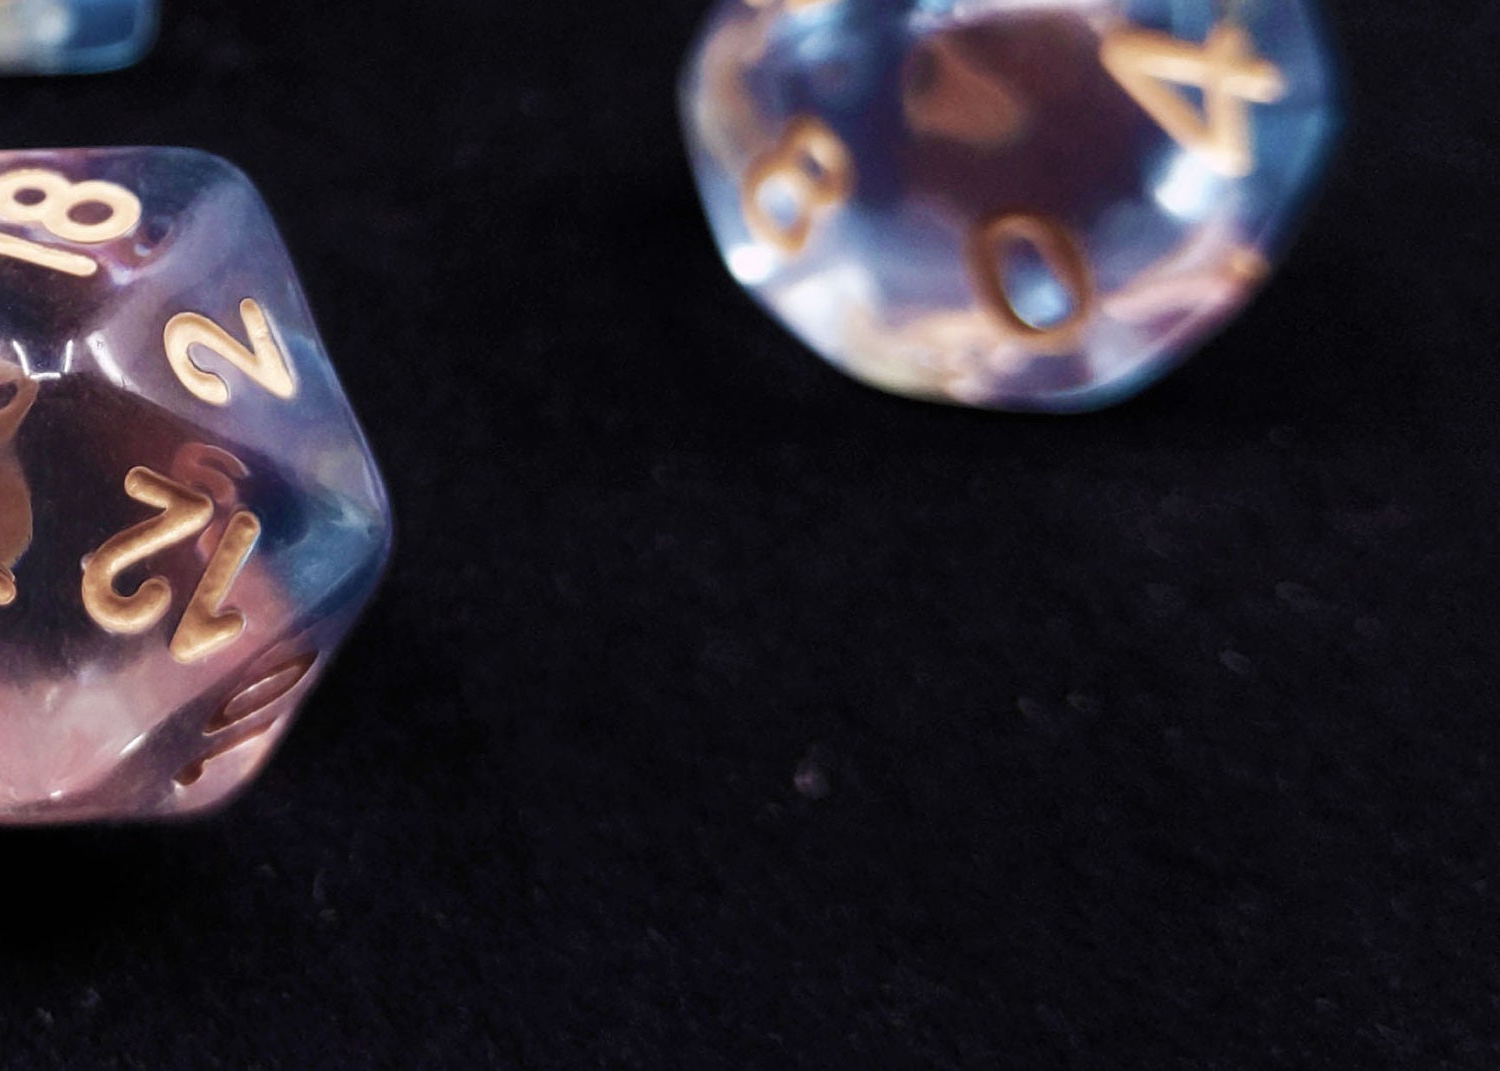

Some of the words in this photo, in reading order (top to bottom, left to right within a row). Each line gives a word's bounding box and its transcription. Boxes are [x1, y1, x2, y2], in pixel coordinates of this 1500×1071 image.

[1100, 20, 1286, 178] 4
[162, 297, 298, 407] 2
[81, 466, 262, 664] 12
